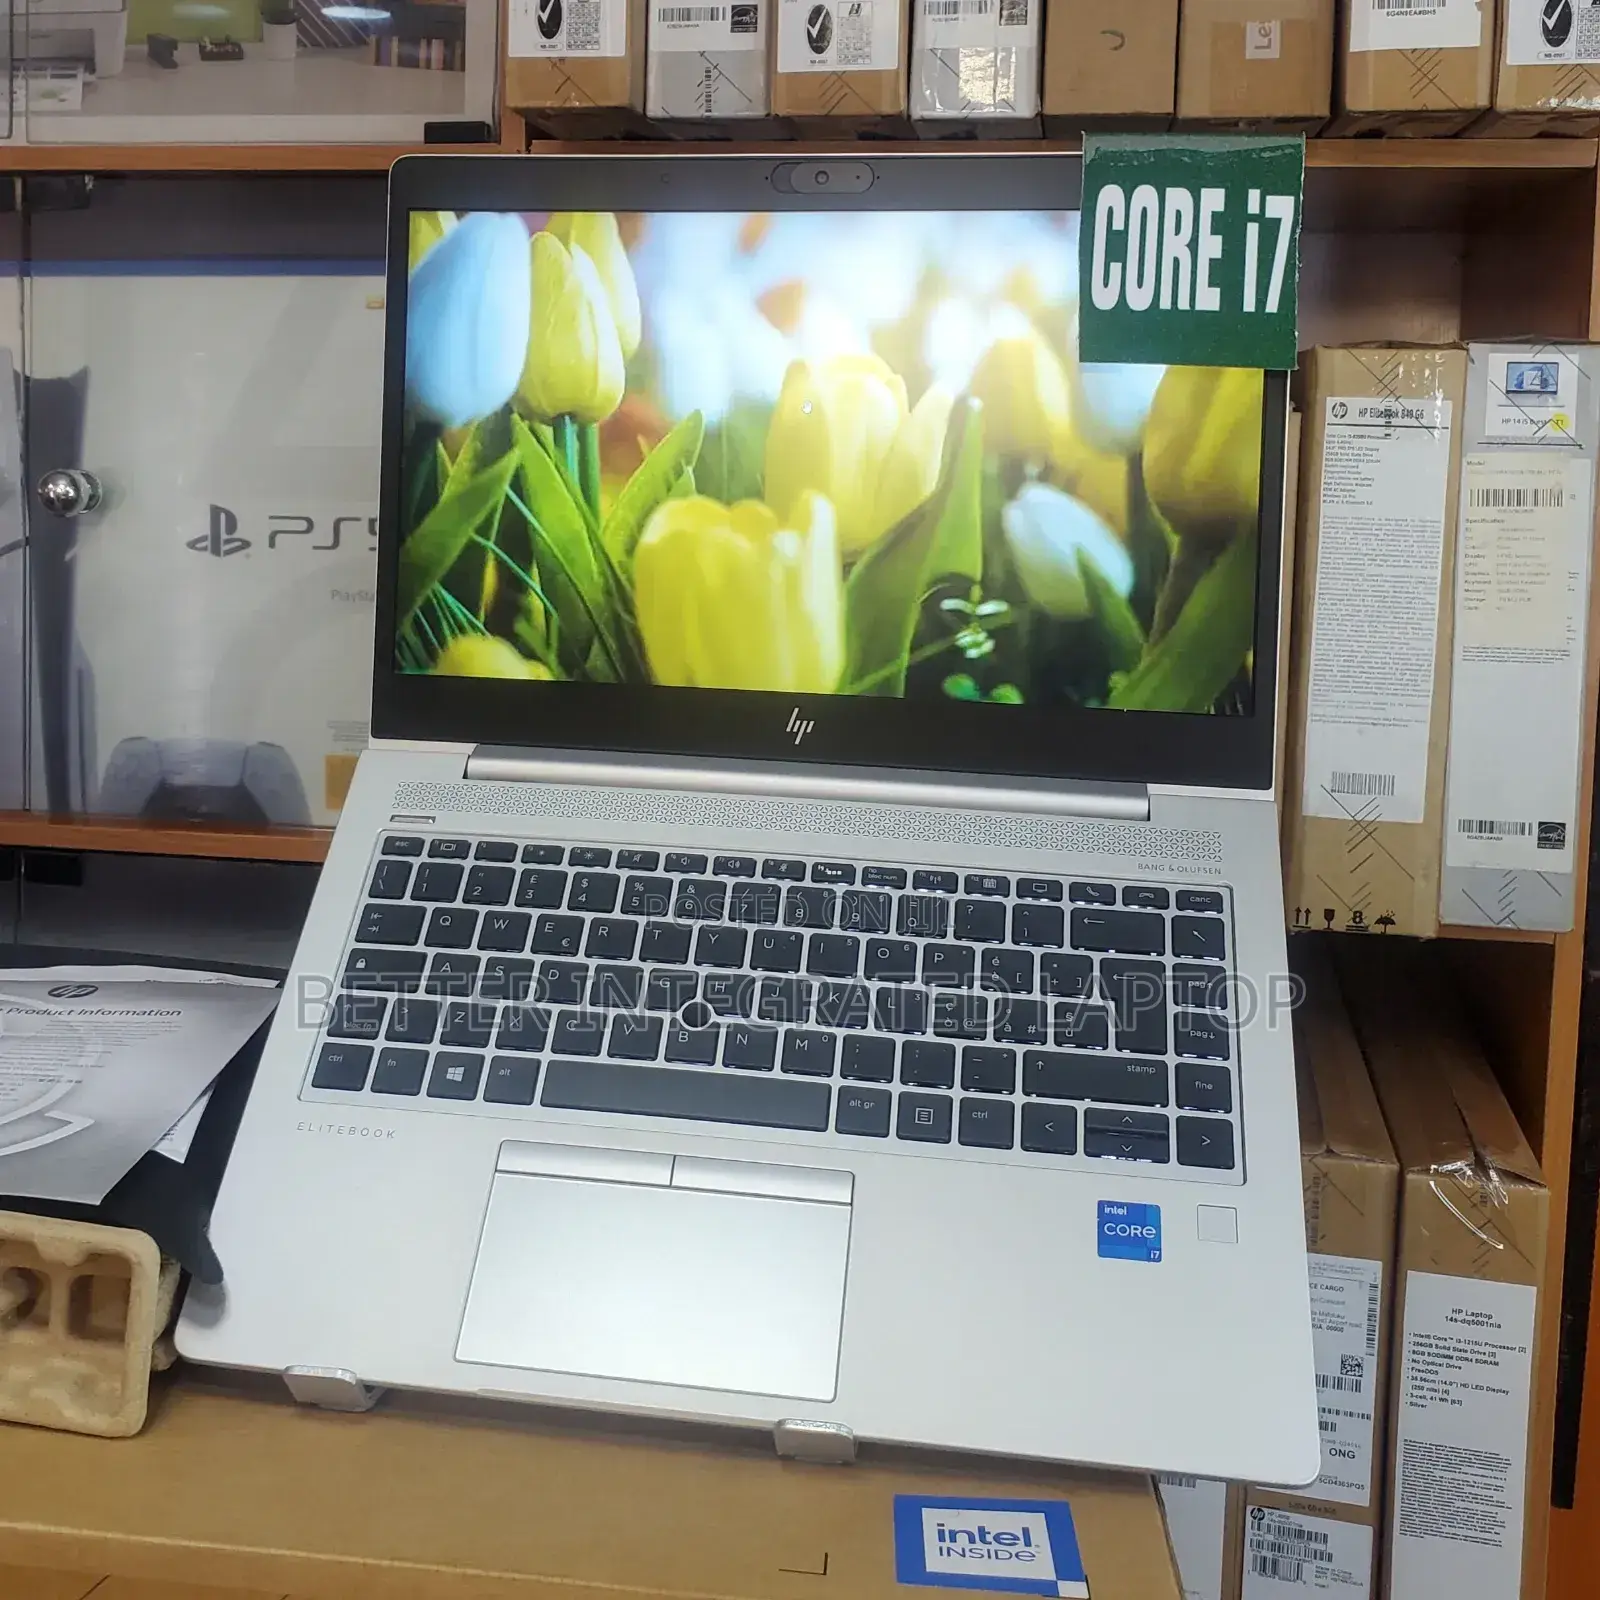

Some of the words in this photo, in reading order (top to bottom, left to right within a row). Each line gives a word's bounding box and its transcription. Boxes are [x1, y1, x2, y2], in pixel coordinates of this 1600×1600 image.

[1254, 21, 1272, 50] Le
[1091, 184, 1226, 312] CORE
[1243, 188, 1295, 313] i7
[1358, 407, 1368, 418] HP
[786, 707, 815, 745] hp
[1137, 862, 1164, 872] BANG
[1168, 865, 1175, 873] &
[1176, 865, 1222, 875] OLUFSEN
[581, 878, 589, 888] $
[633, 882, 644, 892] %
[472, 886, 482, 896] 2
[525, 889, 534, 899] 3
[686, 884, 696, 894] &
[578, 893, 587, 902] 4
[631, 897, 640, 906] 5
[1189, 895, 1211, 904] canc
[684, 900, 694, 910] 6
[739, 903, 748, 913] 7
[795, 908, 804, 918] 8
[851, 912, 860, 922] 9
[439, 915, 452, 926] Q
[493, 918, 509, 930] W
[544, 922, 555, 933] E
[598, 926, 609, 937] R
[652, 930, 662, 940] T
[708, 933, 719, 944] Y
[763, 937, 774, 949] U
[877, 947, 890, 959] O
[934, 952, 944, 963] P
[440, 962, 451, 973] A
[494, 965, 504, 976] S
[548, 970, 560, 980] D
[659, 977, 670, 988] G
[714, 981, 726, 992] H
[1188, 980, 1206, 989] pag
[771, 986, 780, 997] J
[829, 992, 840, 1003] K
[887, 997, 896, 1008] L
[6, 1007, 75, 1016] Product
[78, 1007, 182, 1017] Information
[454, 1011, 465, 1023] Z
[509, 1016, 521, 1027] X
[566, 1020, 577, 1031] C
[624, 1023, 635, 1034] V
[679, 1031, 689, 1042] B
[737, 1034, 748, 1045] N
[1190, 1030, 1207, 1040] pag
[795, 1039, 808, 1051] M
[328, 1053, 343, 1063] ctrl
[387, 1058, 396, 1067] fn
[498, 1067, 511, 1076] alt
[1126, 1064, 1156, 1075] stamp
[1194, 1080, 1213, 1090] fine
[849, 1099, 862, 1107] alt
[864, 1100, 875, 1109] gr
[971, 1109, 988, 1120] ctrl
[297, 1121, 396, 1139] ELITEBOOK
[1104, 1205, 1127, 1216] intel
[1150, 1250, 1160, 1259] i7
[1320, 1283, 1345, 1293] CARGO
[1452, 1307, 1463, 1315] HP
[1465, 1309, 1493, 1320] Laptop
[1412, 1341, 1433, 1349] 256GB
[1452, 1346, 1469, 1354] State
[1470, 1348, 1487, 1356] Drive
[1484, 1342, 1517, 1351] Processor
[1422, 1359, 1444, 1368] Optical
[1445, 1362, 1462, 1370] Drive
[1427, 1351, 1454, 1360] SODIMM
[1455, 1355, 1474, 1363] DDR4
[1475, 1358, 1500, 1367] SDRAM
[1411, 1367, 1439, 1375] FreeDOS
[1486, 1386, 1510, 1395] Display
[1409, 1401, 1428, 1409] Silver
[1329, 1447, 1356, 1460] ONG
